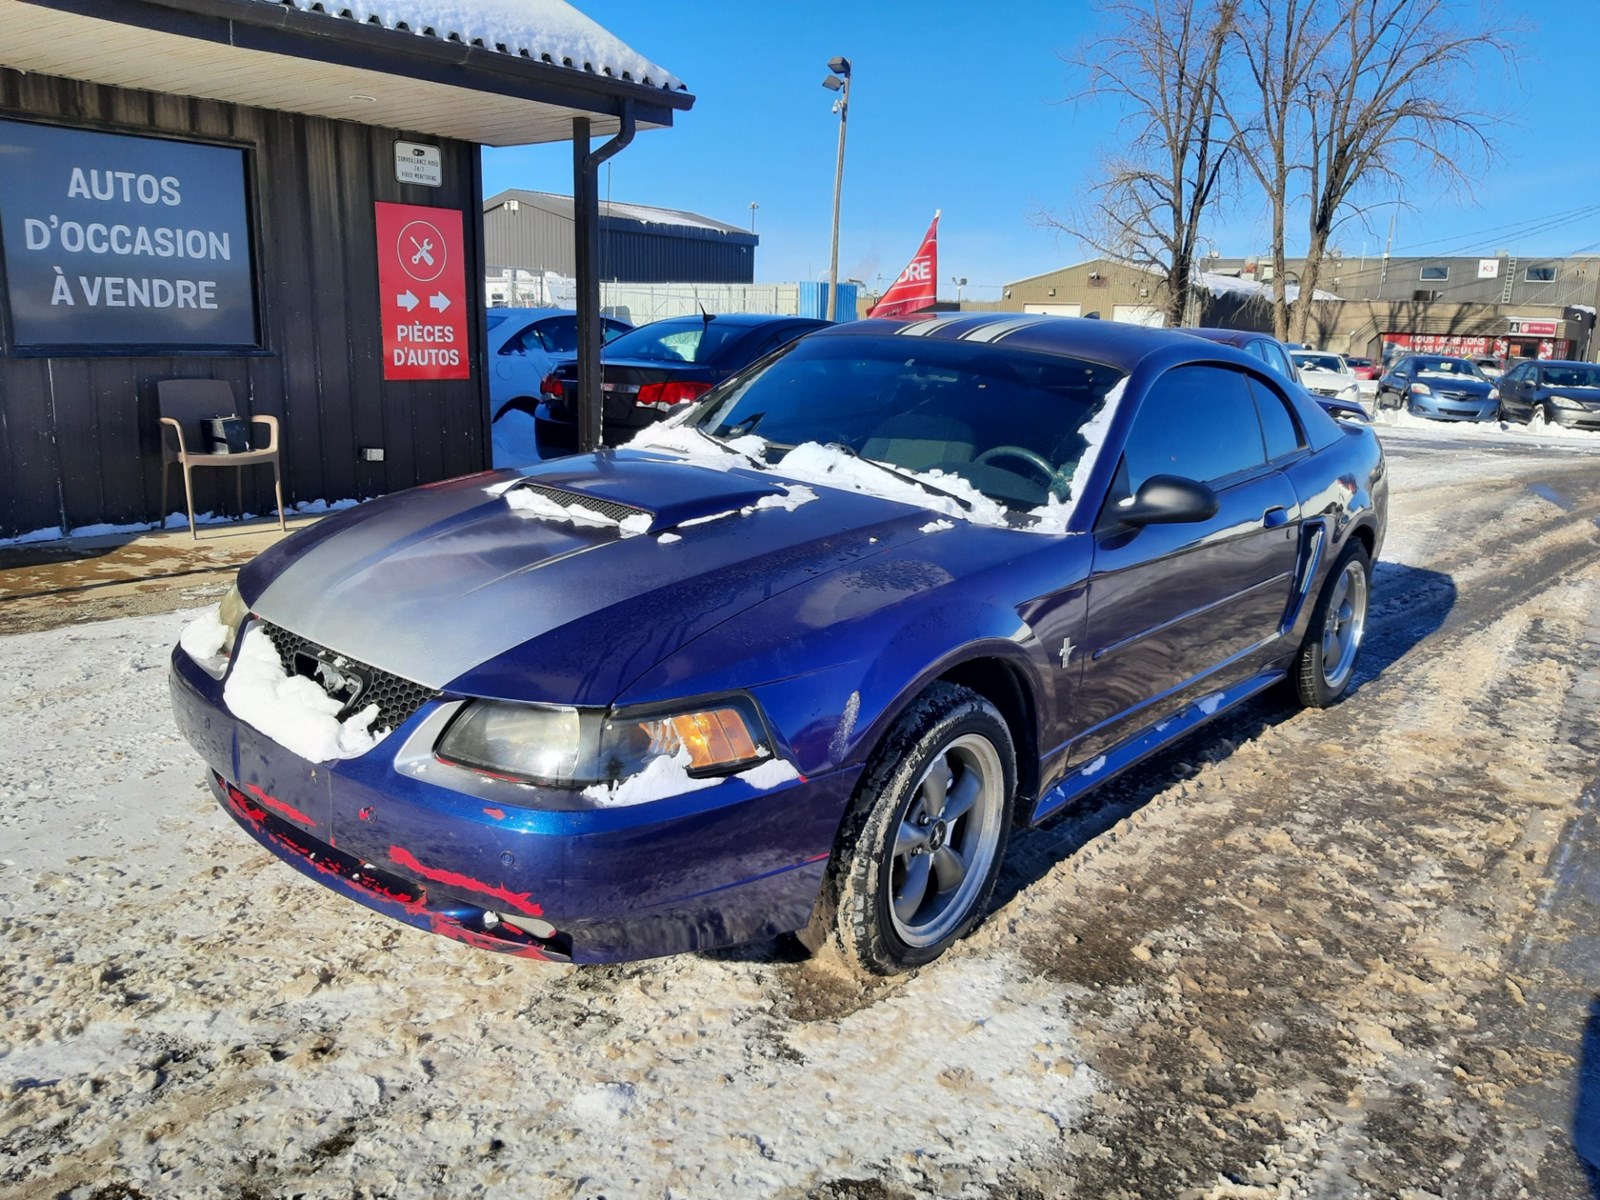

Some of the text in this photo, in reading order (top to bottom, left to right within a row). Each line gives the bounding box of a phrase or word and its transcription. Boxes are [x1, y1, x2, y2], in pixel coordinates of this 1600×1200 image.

[67, 167, 181, 206] AUTOS
[51, 265, 218, 309] À VENDRE
[397, 320, 454, 343] PIÈCES
[1409, 335, 1435, 344] NOUS
[393, 346, 459, 366] D'AUTOS
[1414, 345, 1433, 353] VOS
